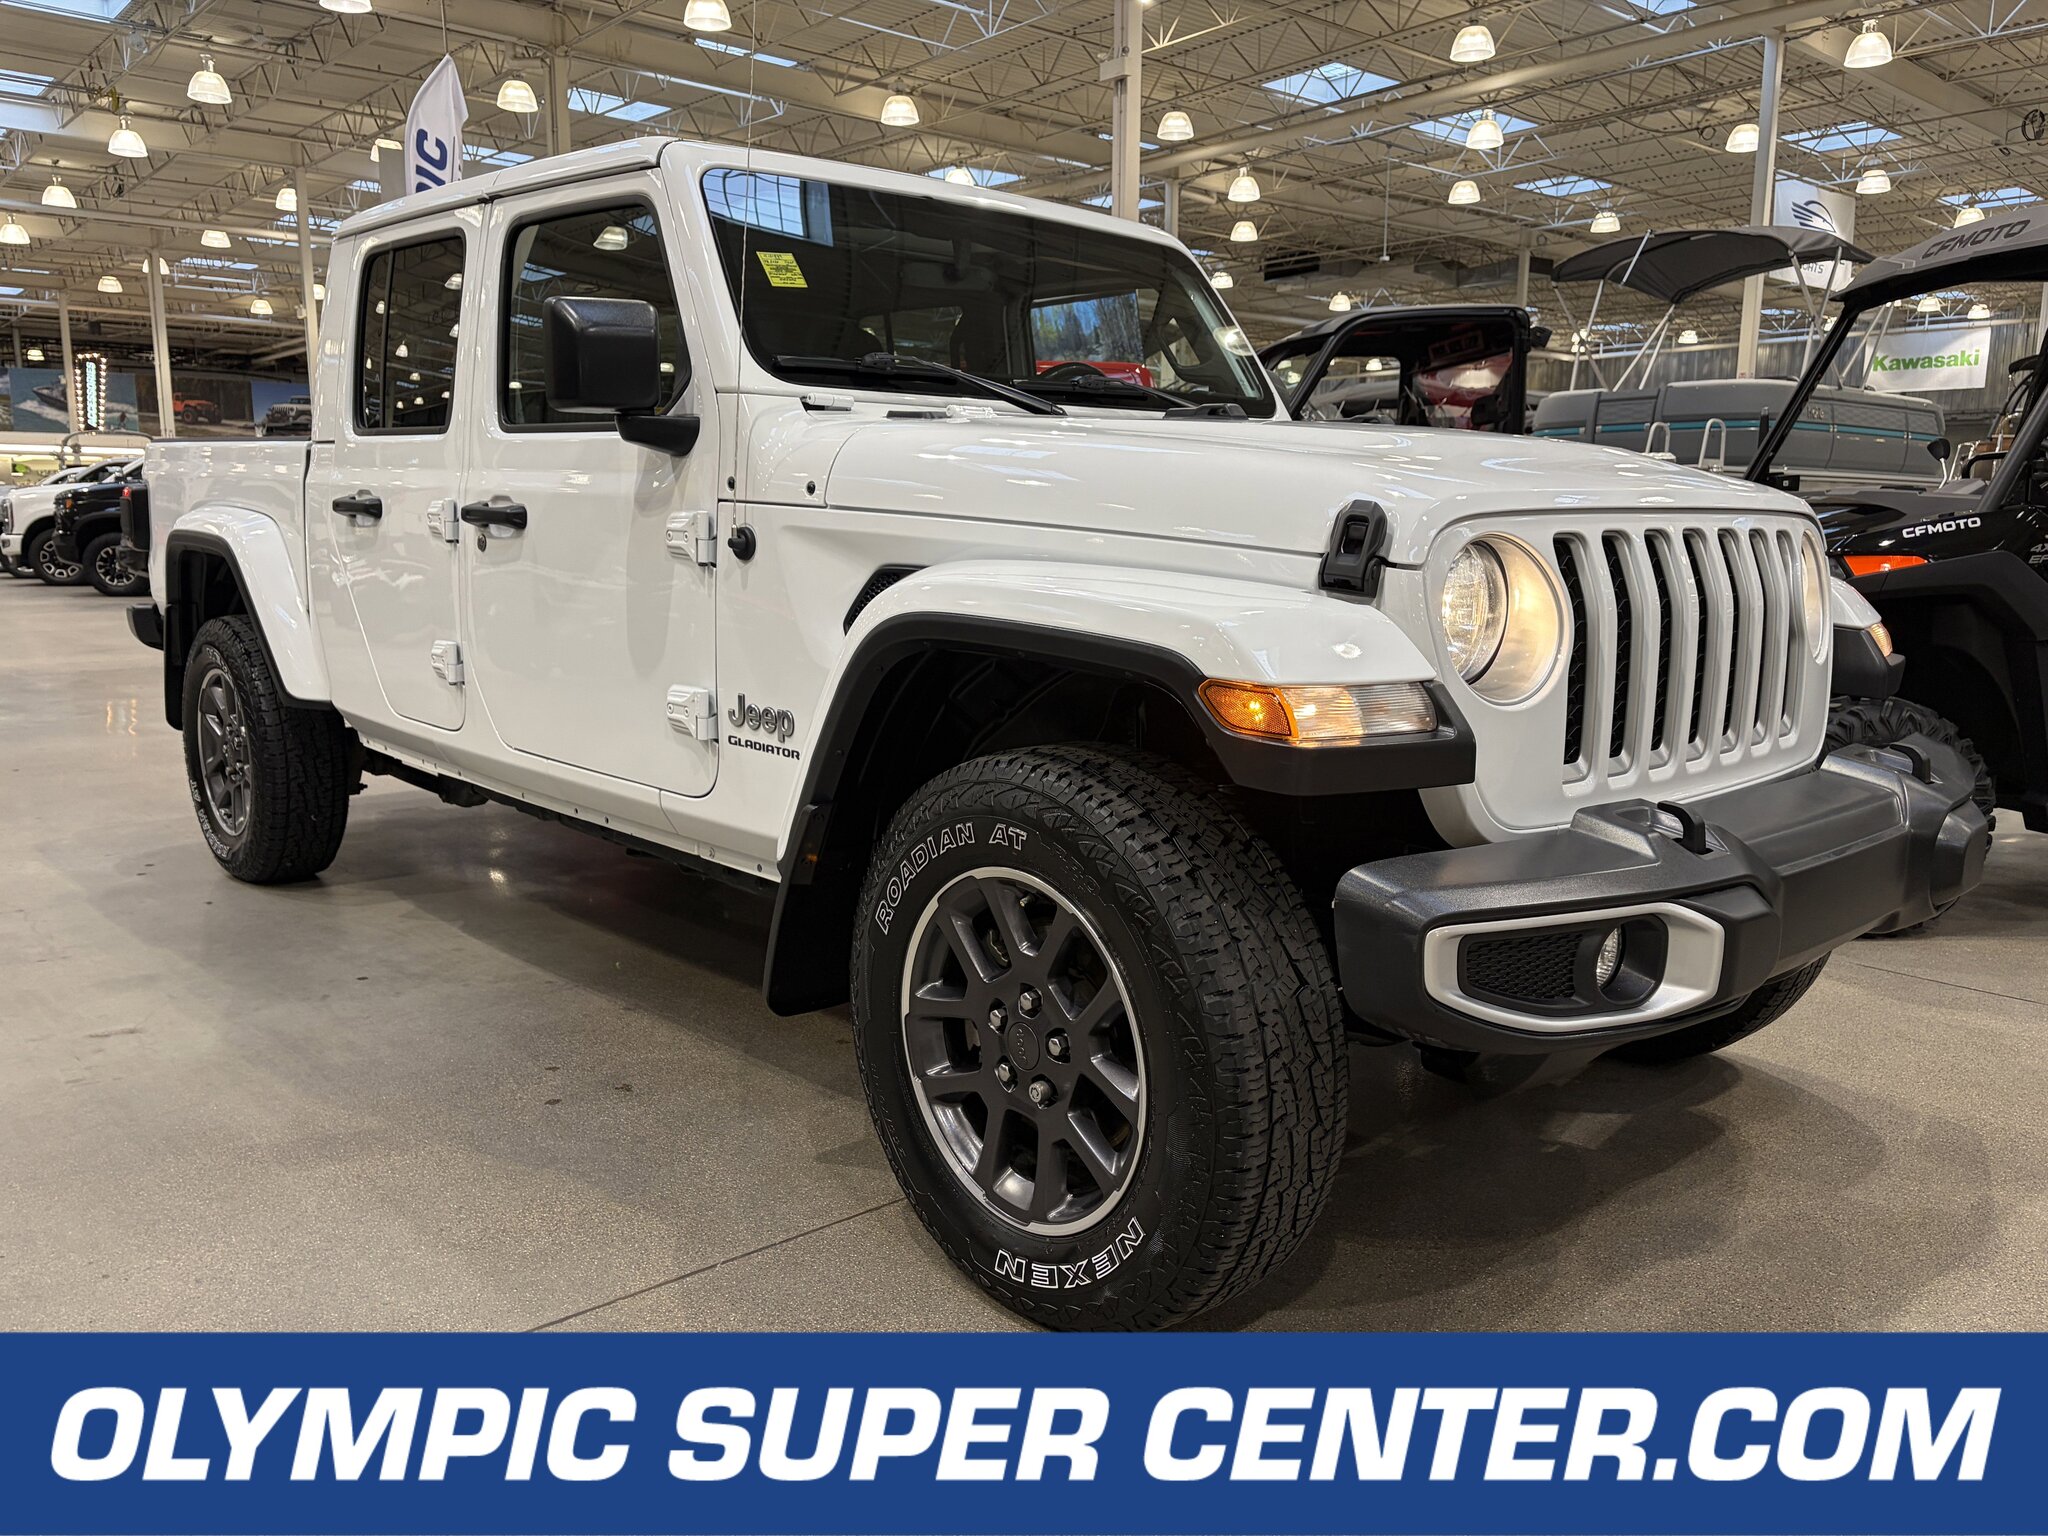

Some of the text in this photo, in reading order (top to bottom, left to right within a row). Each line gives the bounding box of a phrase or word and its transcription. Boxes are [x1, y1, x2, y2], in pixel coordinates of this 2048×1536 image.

[416, 128, 448, 193] IC
[1921, 219, 2031, 260] CFMOTO
[1872, 349, 1980, 373] Kawasaki
[1902, 517, 1982, 539] CFMOTO
[728, 692, 795, 744] Jeep
[727, 734, 801, 761] GLADIATOR
[875, 822, 976, 936] ROADIAN
[988, 822, 1028, 850] AT
[994, 1216, 1147, 1289] NEXEN
